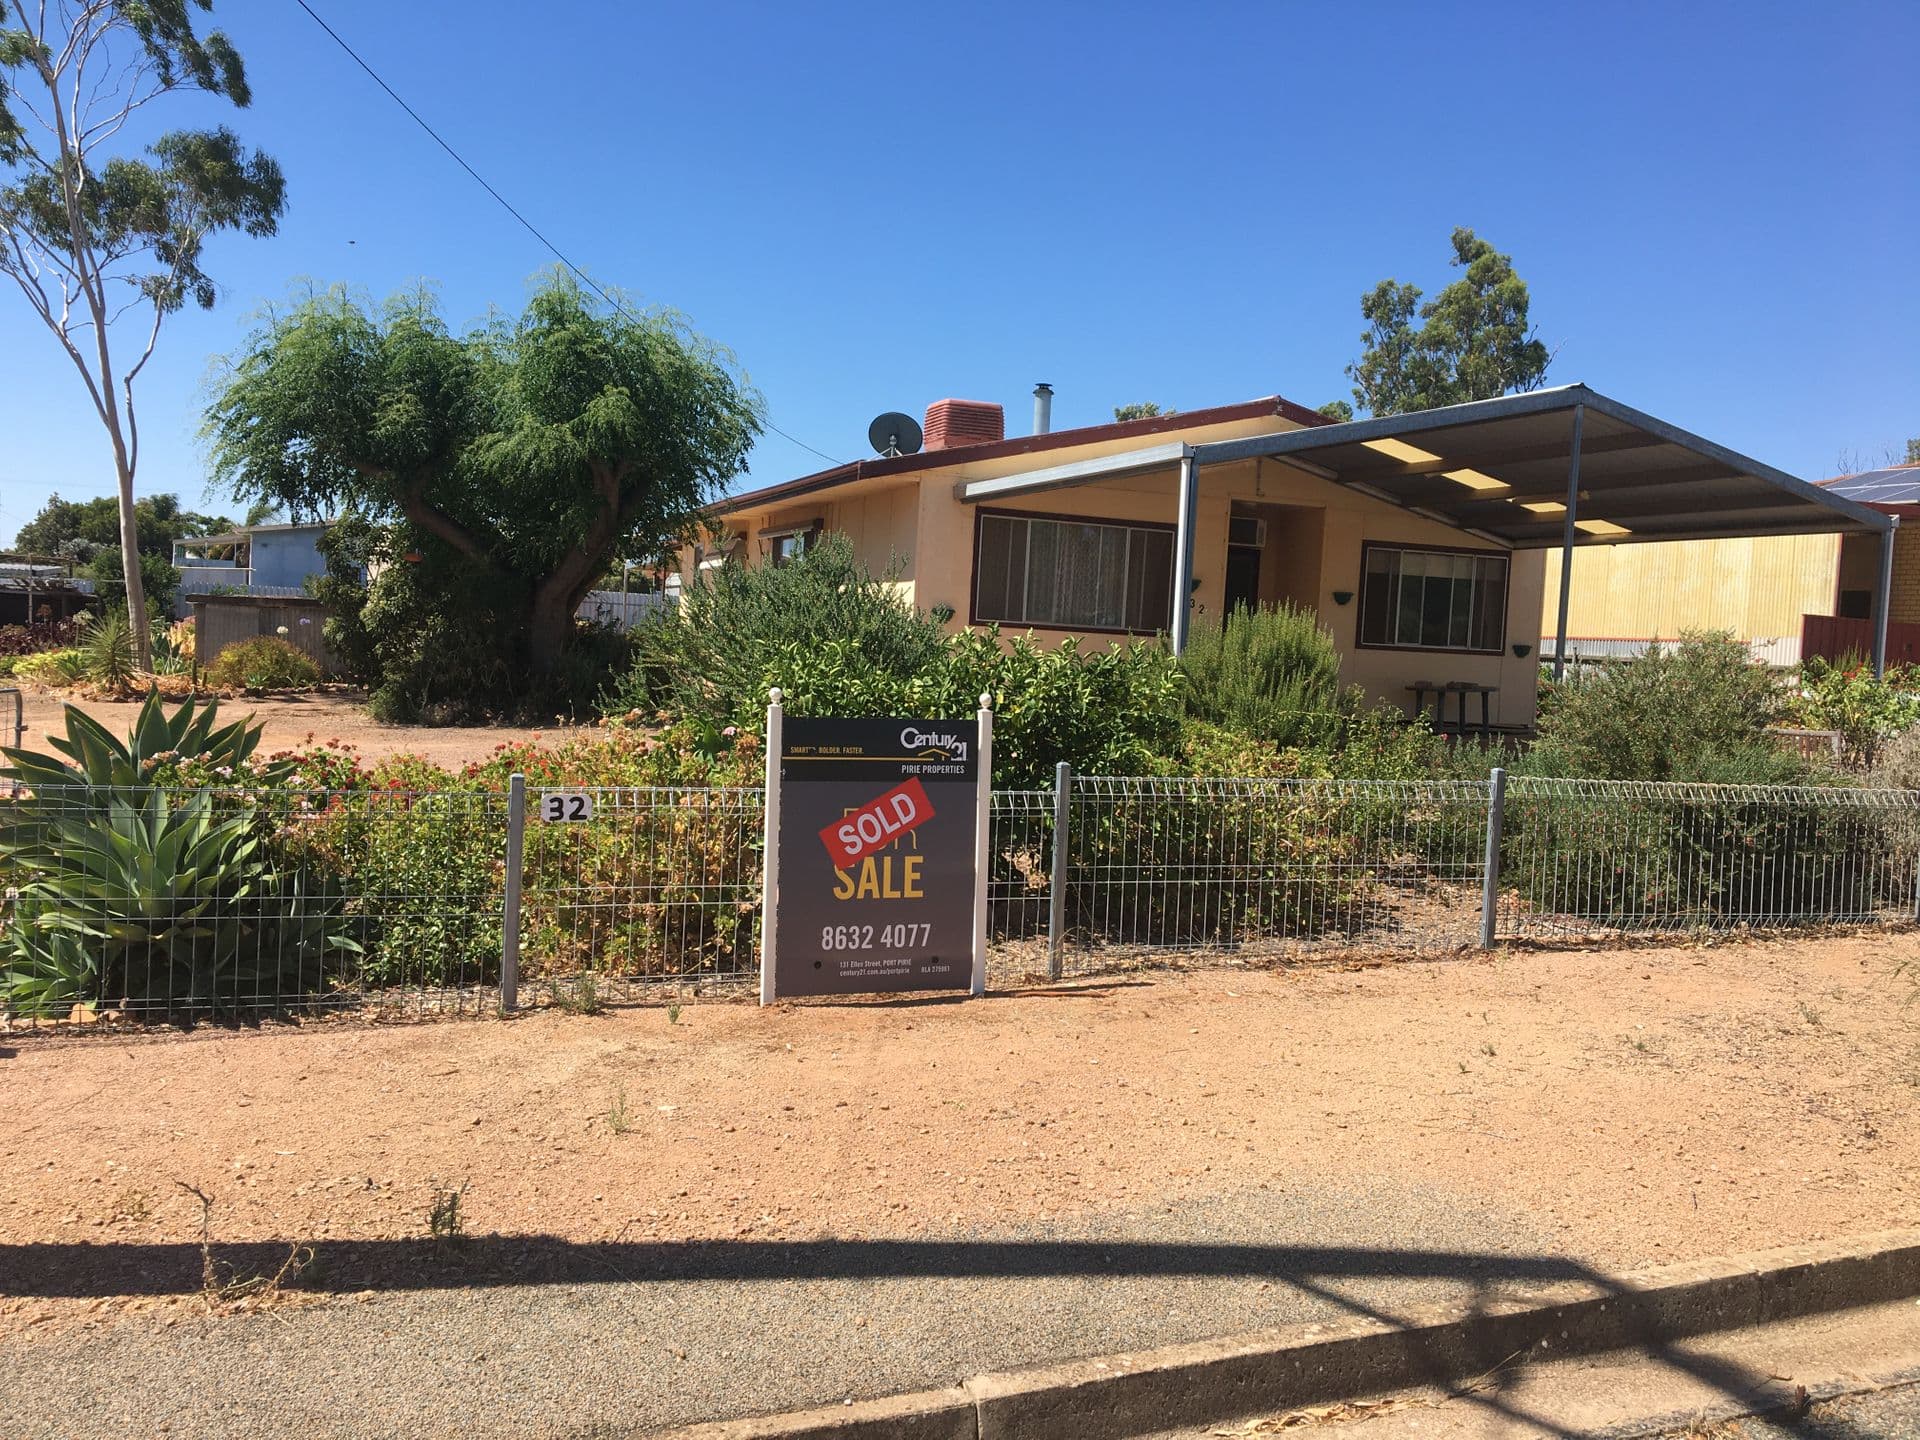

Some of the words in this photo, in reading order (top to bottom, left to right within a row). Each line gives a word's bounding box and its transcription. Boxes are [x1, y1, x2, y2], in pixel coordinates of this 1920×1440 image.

[901, 727, 957, 749] Century
[950, 742, 967, 762] 21
[901, 765, 921, 774] PIRIE
[922, 765, 965, 774] PROPERTIES
[549, 796, 588, 821] 32
[838, 793, 916, 855] SOLD
[832, 855, 924, 901] SALE
[821, 925, 874, 950] 8632
[880, 923, 931, 948] 4077
